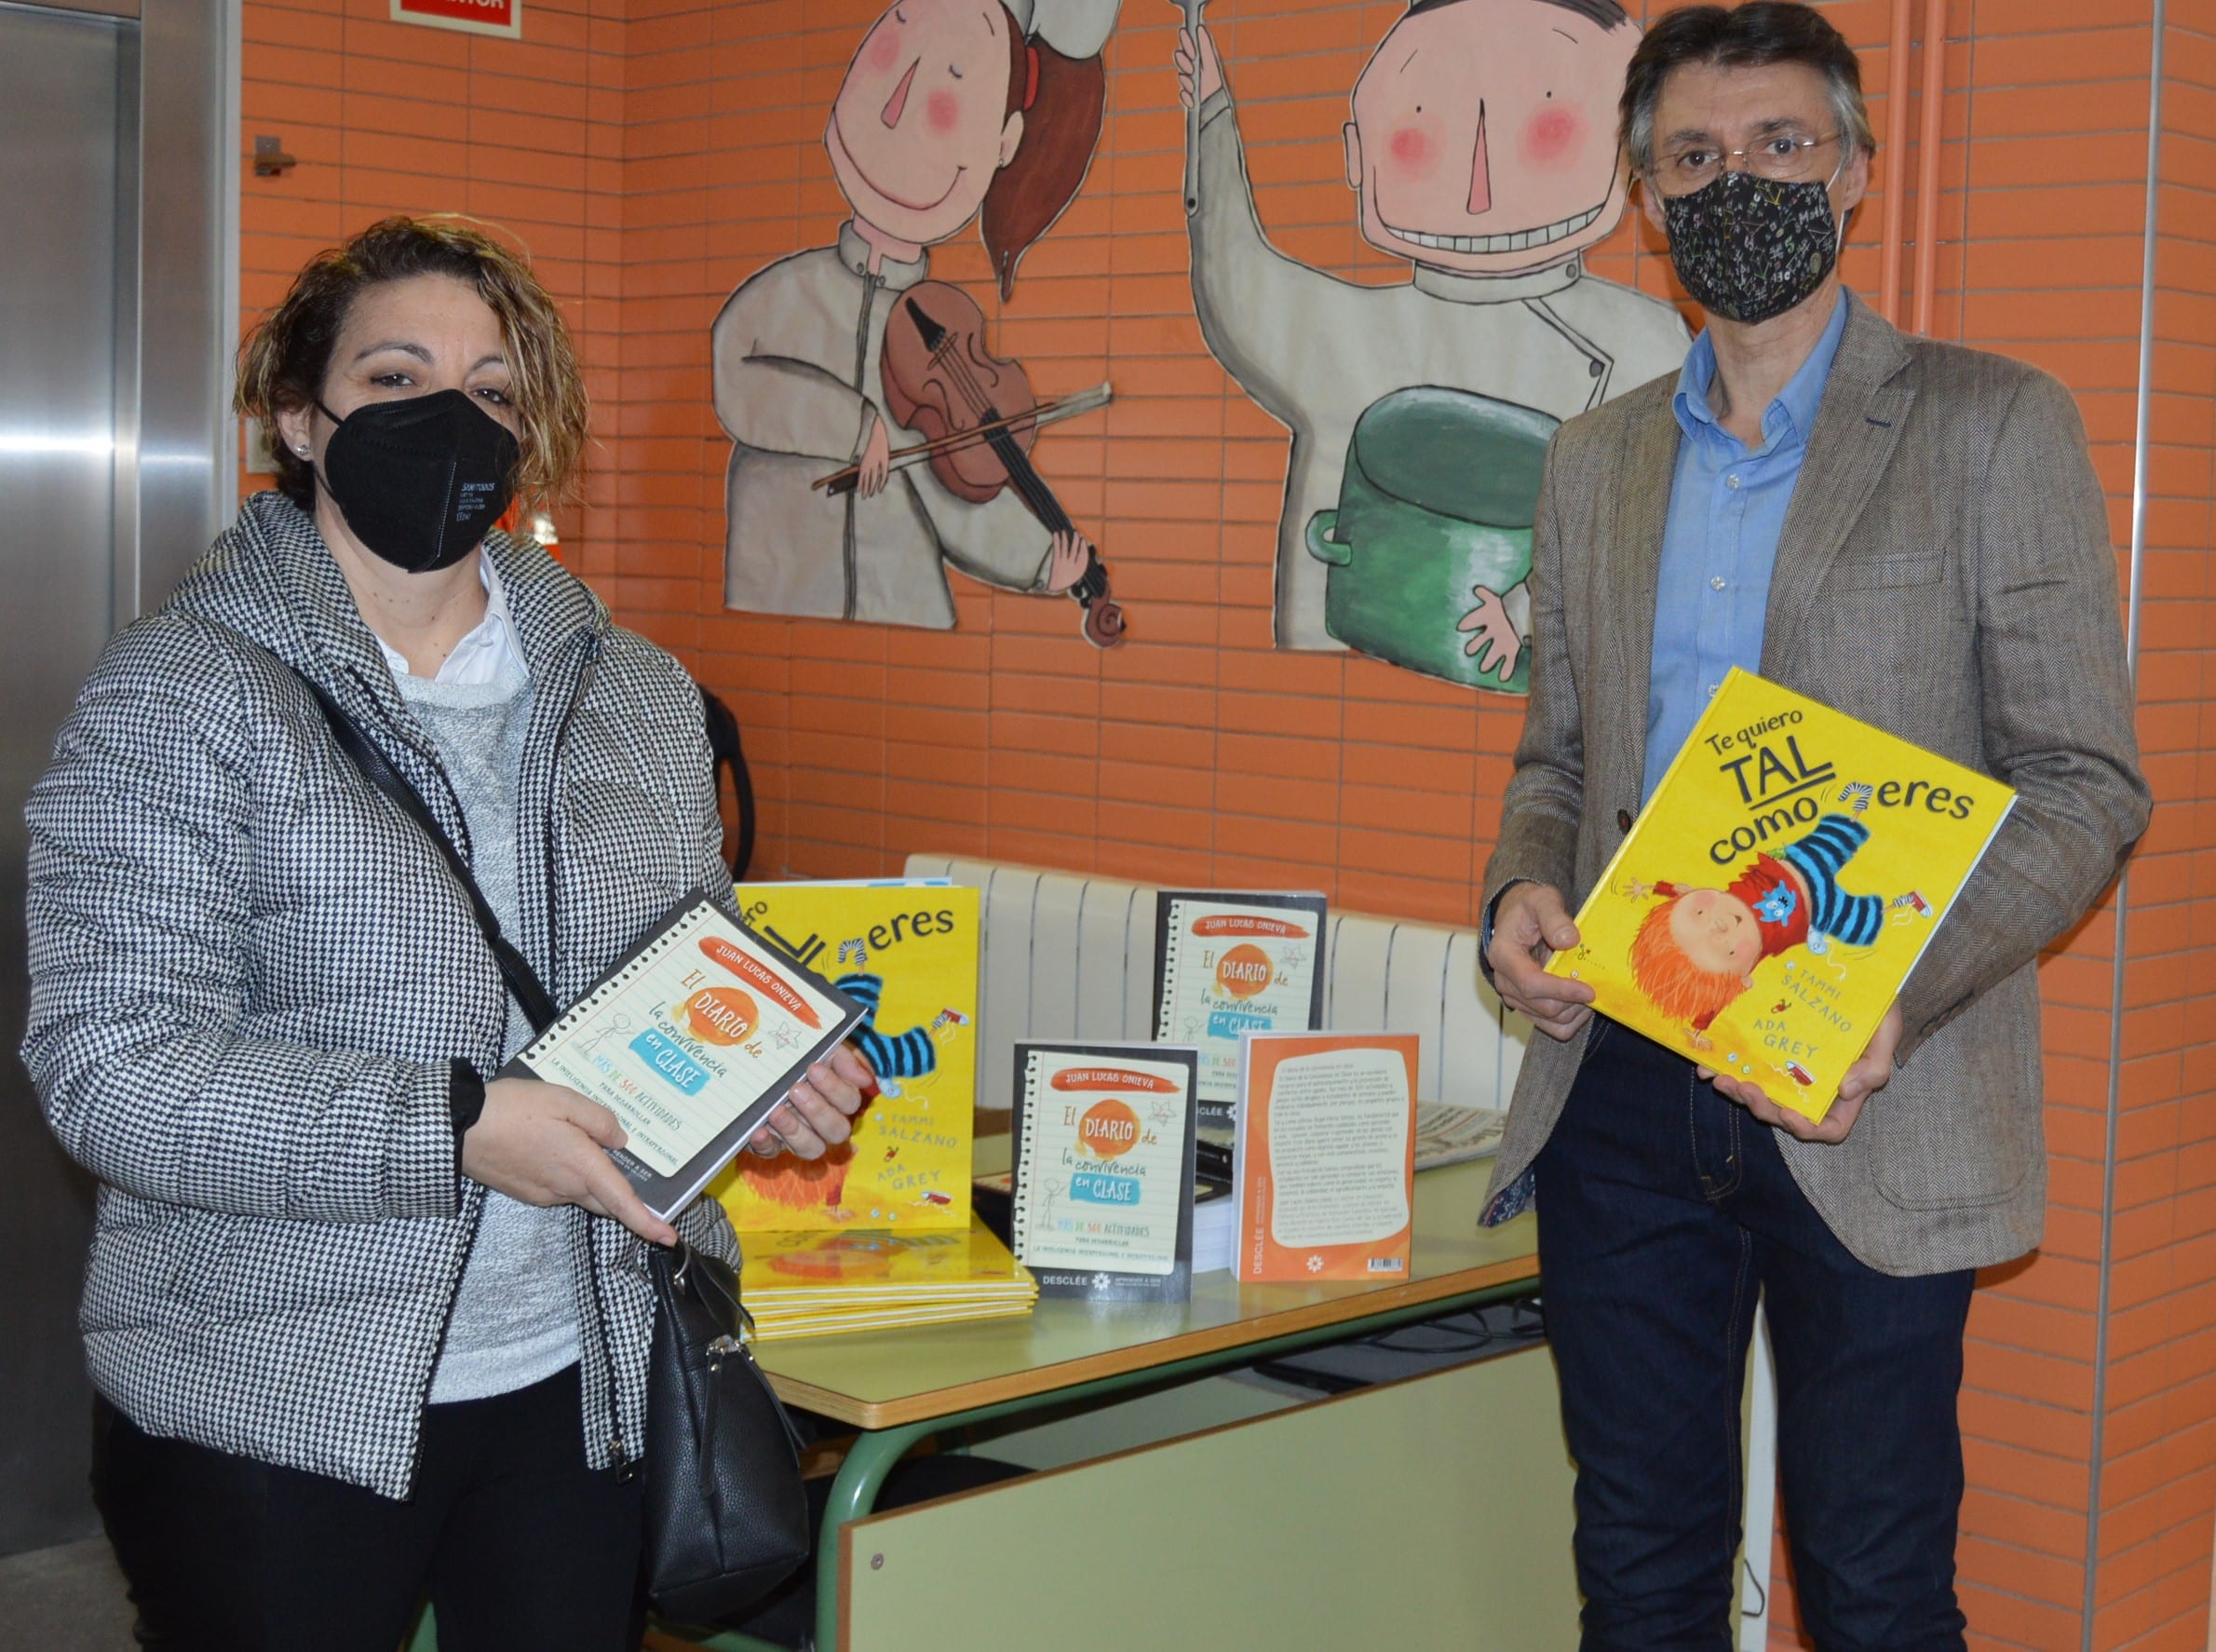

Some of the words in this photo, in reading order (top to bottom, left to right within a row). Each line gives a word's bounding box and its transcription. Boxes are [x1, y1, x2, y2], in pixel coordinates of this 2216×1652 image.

[1704, 733, 1735, 756] Te
[1736, 710, 1804, 749] quiero
[1719, 735, 1834, 805] TAL
[1709, 796, 1818, 866] como
[1877, 779, 1975, 820] eres
[867, 909, 954, 951] eres
[1206, 920, 1226, 929] JUAN
[716, 945, 743, 965] JUAN
[743, 961, 771, 984] LUCAS
[771, 981, 803, 1011] ONIEVA
[1203, 950, 1214, 968] El
[1223, 961, 1266, 982] DIARIO
[1274, 971, 1288, 986] de
[1801, 969, 1842, 1000] TAMMI
[649, 1001, 666, 1020] la
[681, 968, 706, 990] El
[694, 992, 750, 1038] DIARIO
[745, 1041, 763, 1059] de
[1201, 988, 1210, 1005] la
[1212, 999, 1278, 1015] convivencia
[1782, 975, 1852, 1032] SALZANO
[1213, 1016, 1225, 1025] en
[1753, 1019, 1786, 1031] ADA
[657, 1022, 728, 1077] convivencia
[1764, 1034, 1818, 1059] GREY
[551, 1057, 560, 1066] LA
[645, 1033, 663, 1049] en
[655, 1049, 701, 1089] CLASE
[599, 1082, 615, 1096] PARA
[1065, 1073, 1089, 1083] JUAN
[1092, 1072, 1119, 1082] LUCAS
[1122, 1075, 1155, 1089] ONIEVA
[635, 1091, 682, 1131] ACTIVIDADES
[892, 1114, 935, 1126] TAMMI
[879, 1124, 957, 1148] SALZANO
[1063, 1106, 1076, 1126] El
[1085, 1118, 1133, 1141] DIARIO
[1142, 1129, 1157, 1144] de
[877, 1164, 906, 1182] ADA
[1061, 1147, 1073, 1165] la
[1074, 1160, 1147, 1176] convivencia
[892, 1170, 940, 1190] GREY
[1075, 1176, 1089, 1187] en
[1093, 1180, 1131, 1200] CLASE
[1103, 1224, 1150, 1238] ACTIVIDADES
[1043, 1274, 1088, 1286] DESCLÉE
